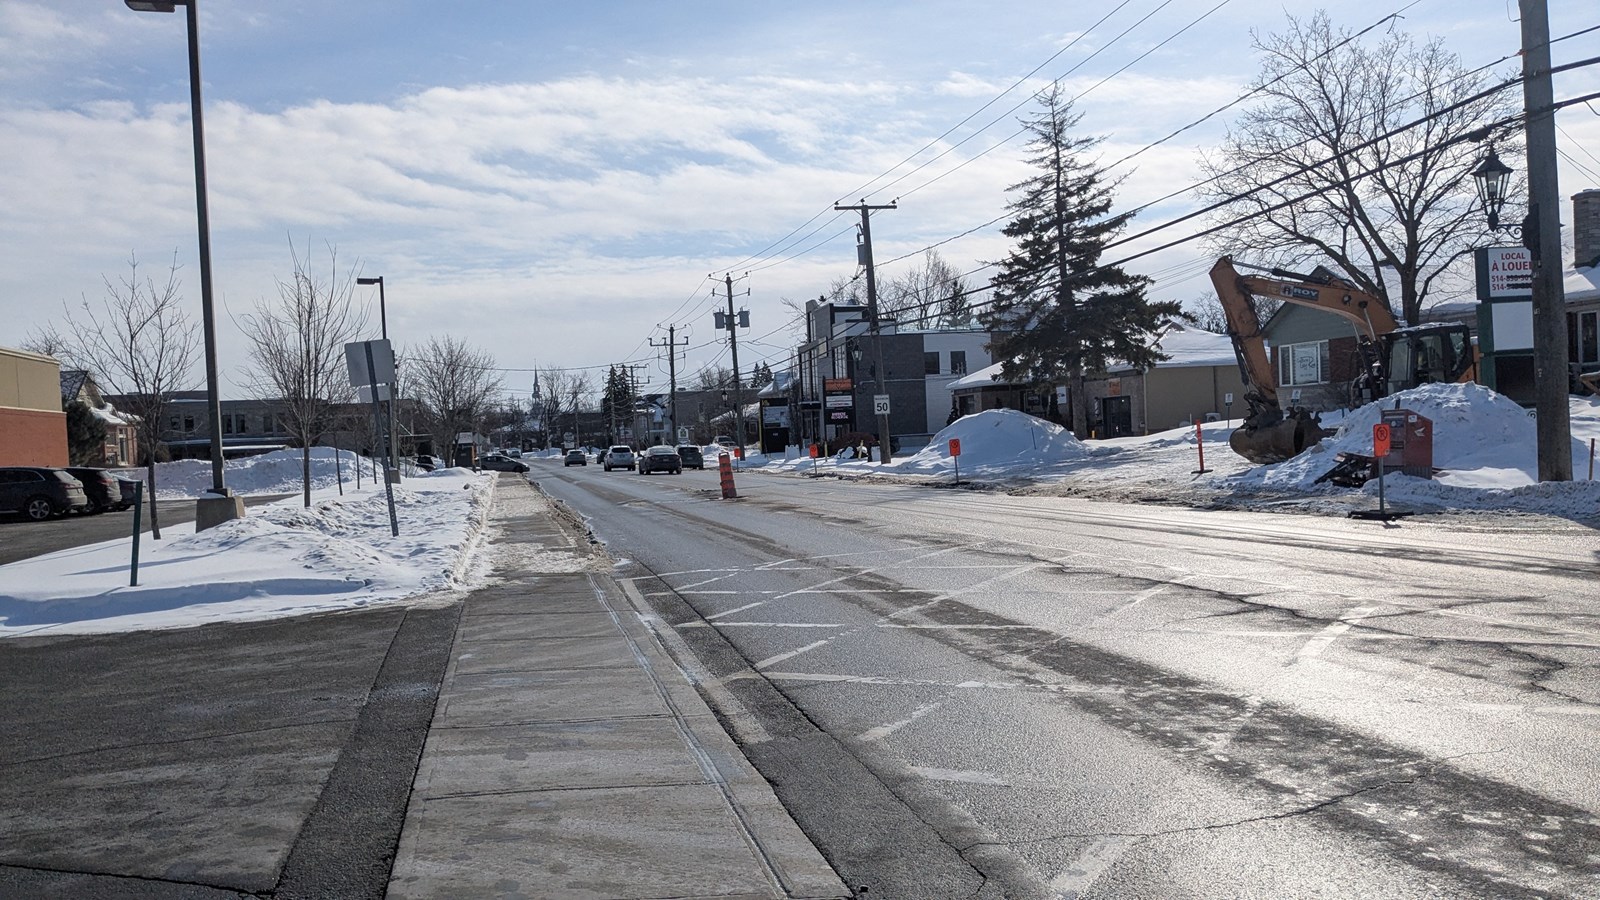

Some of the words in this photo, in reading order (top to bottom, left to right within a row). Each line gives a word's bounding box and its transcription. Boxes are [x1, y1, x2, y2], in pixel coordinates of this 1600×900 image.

[1501, 252, 1525, 260] LOCAL
[1491, 260, 1499, 272] À
[1293, 287, 1318, 297] ROY
[876, 402, 888, 412] 50
